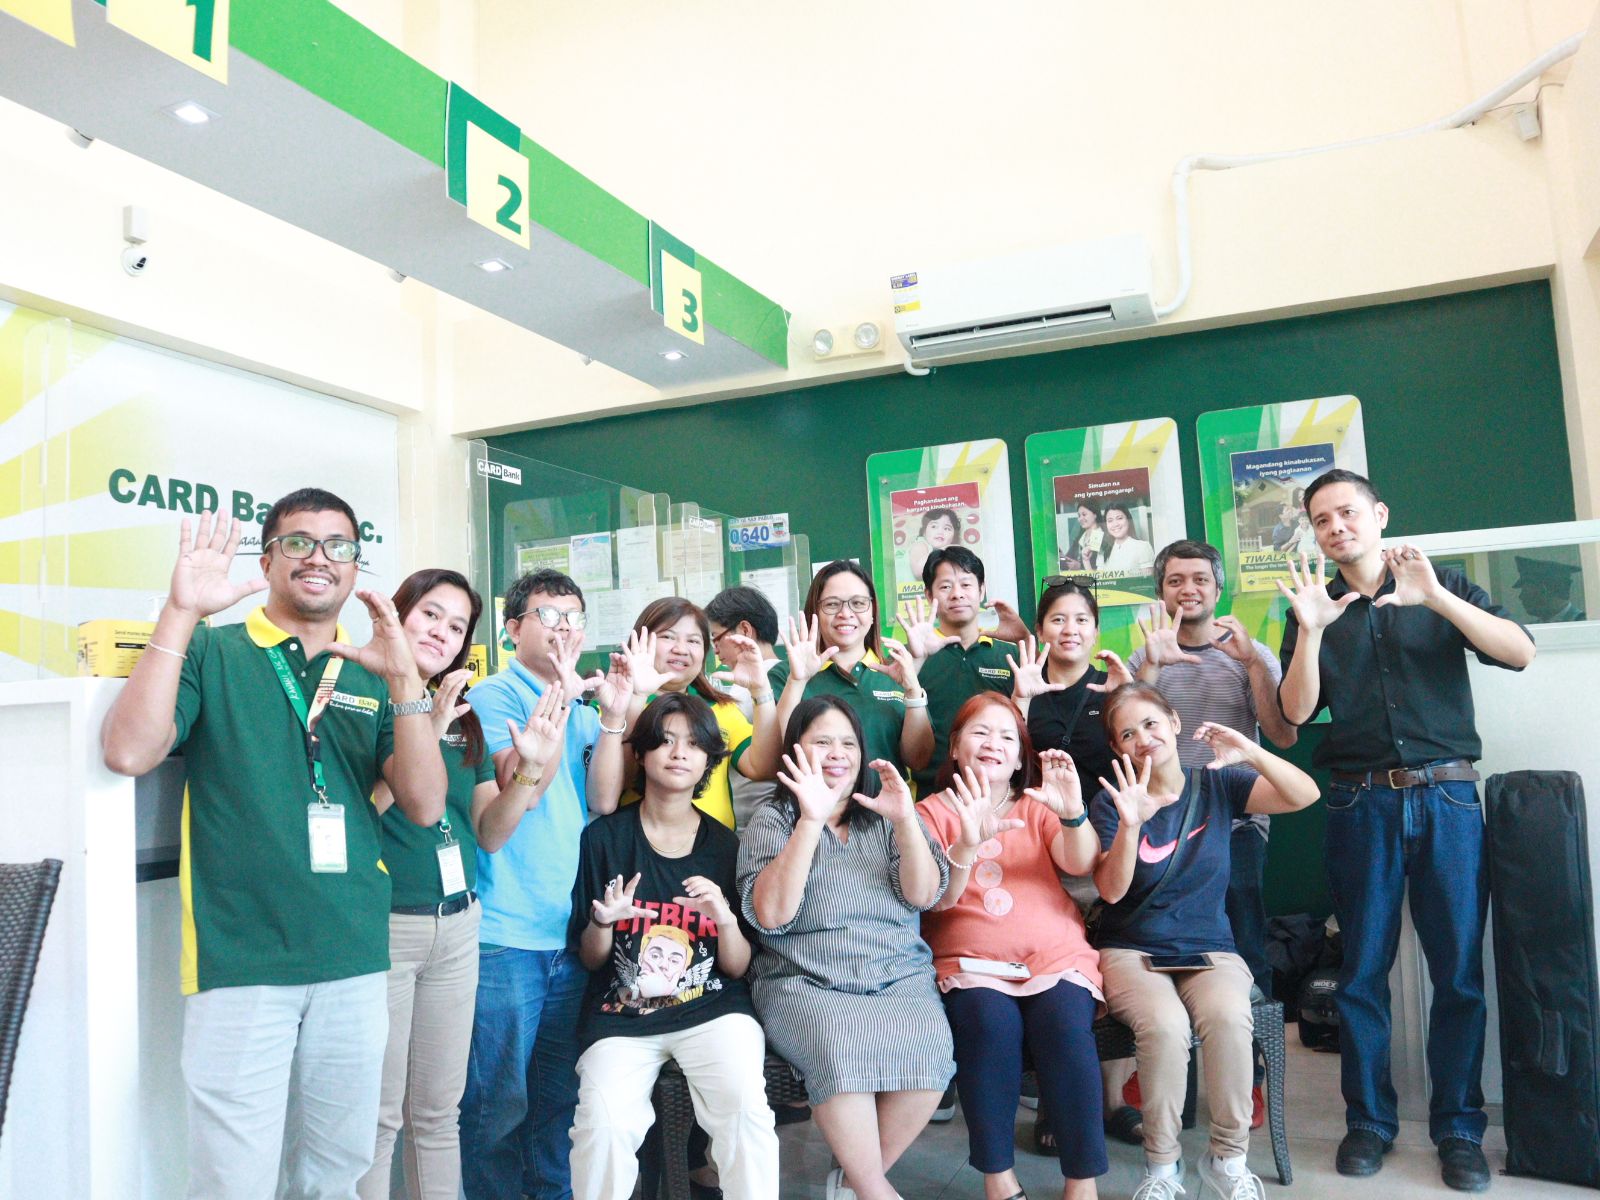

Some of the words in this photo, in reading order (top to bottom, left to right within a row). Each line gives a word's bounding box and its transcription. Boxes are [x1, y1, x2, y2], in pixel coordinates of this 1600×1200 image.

[186, 0, 213, 63] 1
[496, 174, 523, 235] 2
[681, 288, 699, 333] 3
[478, 461, 502, 476] CARD
[503, 468, 520, 481] Bank
[1246, 462, 1283, 471] Magandang
[1279, 466, 1312, 476] paglaanan
[108, 468, 219, 516] CARD
[232, 490, 272, 526] Ba
[730, 525, 770, 544] 0640
[1245, 553, 1288, 563] TIWALA
[902, 584, 925, 593] MAA
